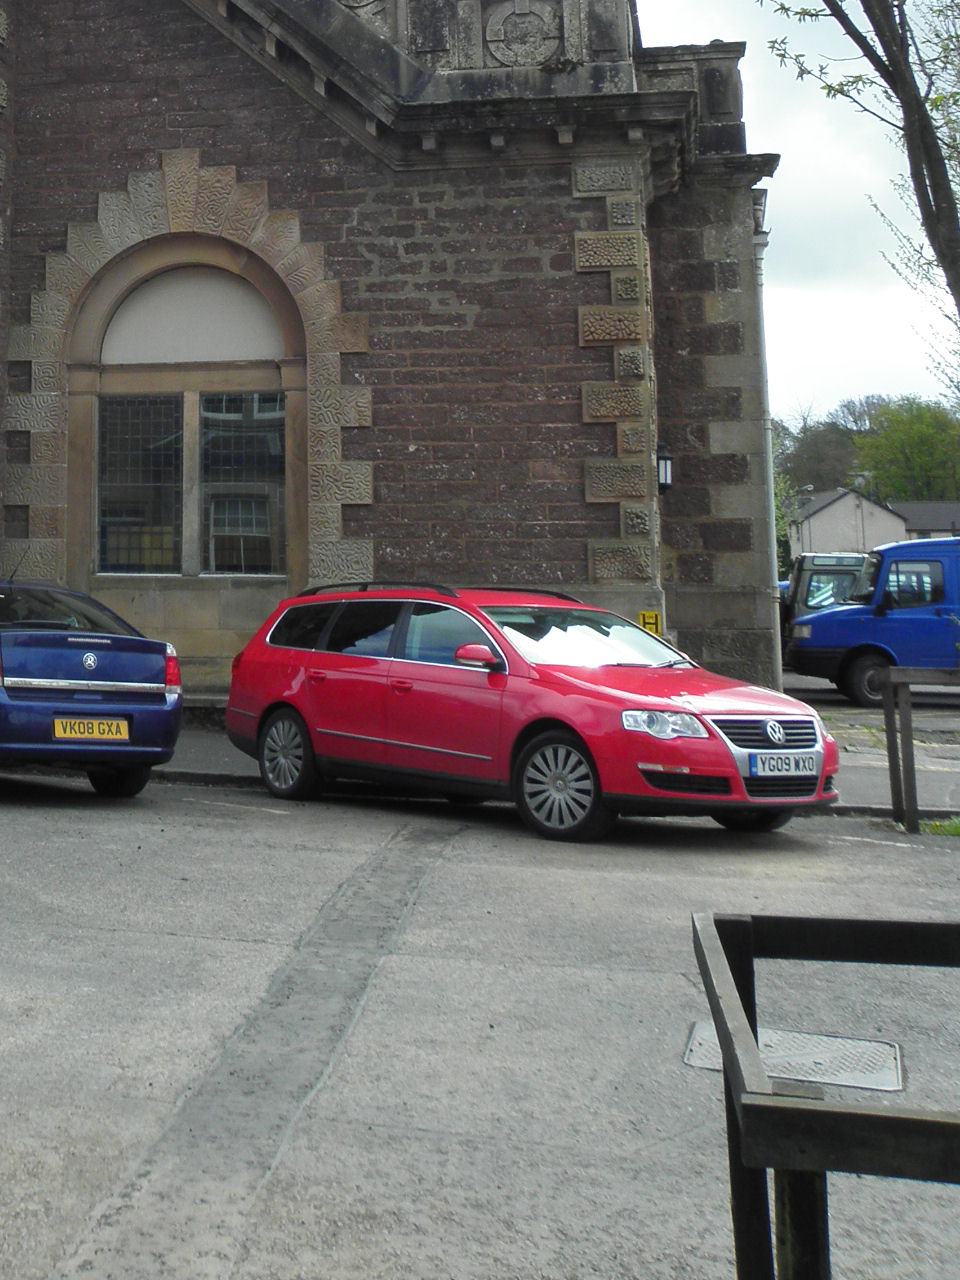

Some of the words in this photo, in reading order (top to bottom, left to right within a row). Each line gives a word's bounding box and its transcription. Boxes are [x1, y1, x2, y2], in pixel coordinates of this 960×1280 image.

[60, 721, 95, 735] VK08
[97, 722, 123, 736] GXA
[759, 756, 791, 772] YG09
[793, 756, 815, 772] WXO
